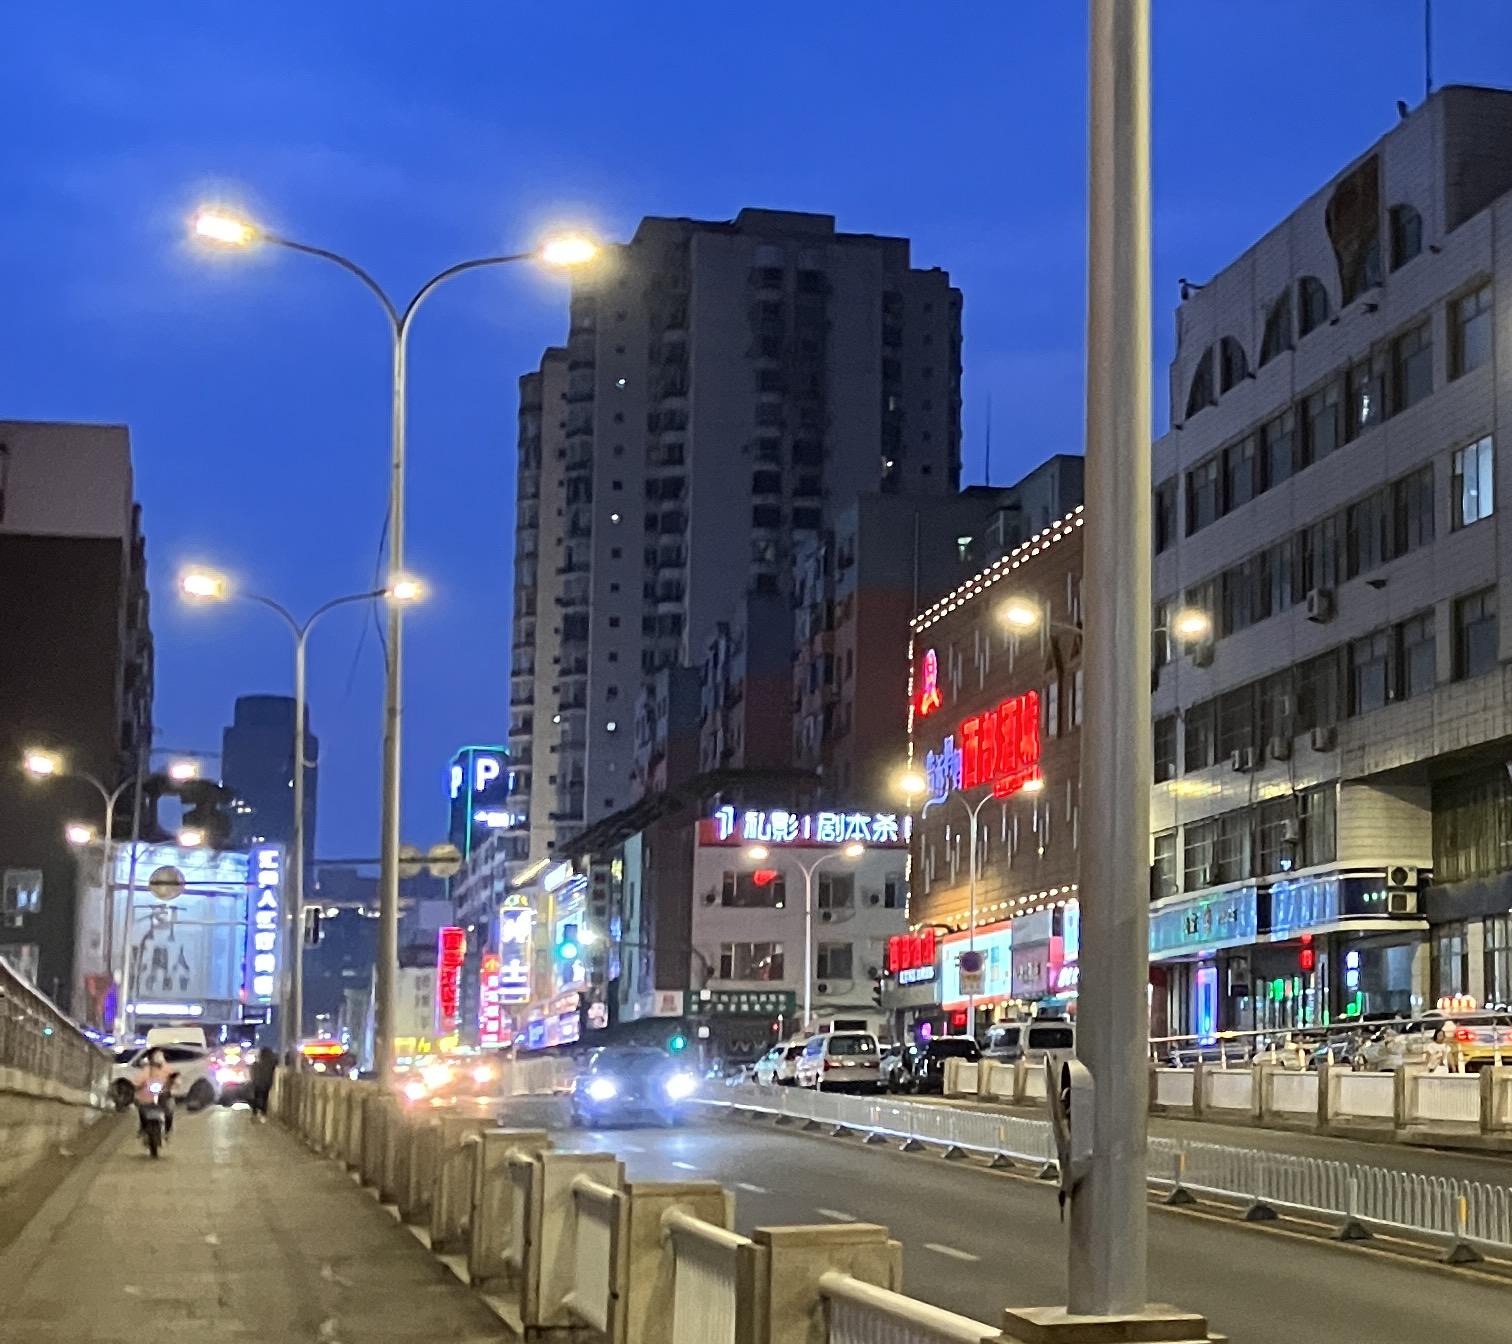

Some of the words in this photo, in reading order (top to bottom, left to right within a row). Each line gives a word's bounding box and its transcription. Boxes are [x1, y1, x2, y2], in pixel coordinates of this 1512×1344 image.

[476, 758, 500, 791] P
[818, 812, 897, 843] 剧本杀
